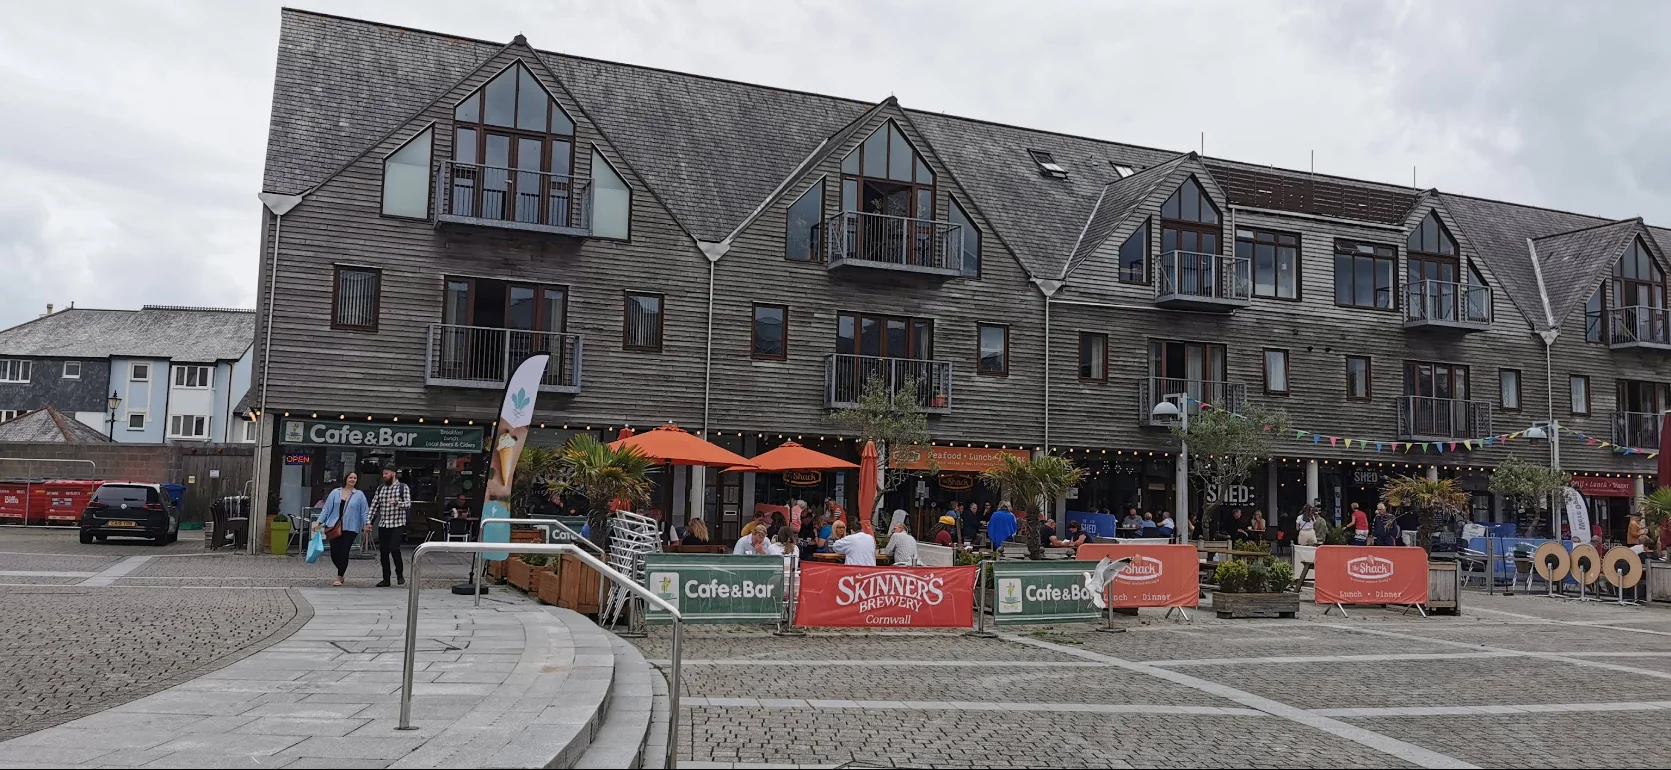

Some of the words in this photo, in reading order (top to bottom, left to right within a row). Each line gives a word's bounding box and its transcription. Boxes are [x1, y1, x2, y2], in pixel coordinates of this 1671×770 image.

[309, 423, 418, 447] Cafe&Bar
[286, 455, 310, 463] OPEN
[928, 451, 962, 460] Seafood
[969, 453, 994, 461] Lunch
[1354, 471, 1378, 483] SHED
[1125, 563, 1156, 575] Shack
[1360, 562, 1388, 574] Shack
[684, 578, 775, 599] Cafe&Bar
[836, 573, 944, 606] SKINNER'S
[1025, 584, 1093, 602] Cafe&Ba
[1339, 590, 1363, 598] Lunch
[1375, 590, 1402, 598] Dinner
[1103, 593, 1128, 601] Lnch
[1142, 593, 1171, 601] Dinner
[859, 595, 923, 613] BREWERY
[865, 614, 911, 625] Cornwall
